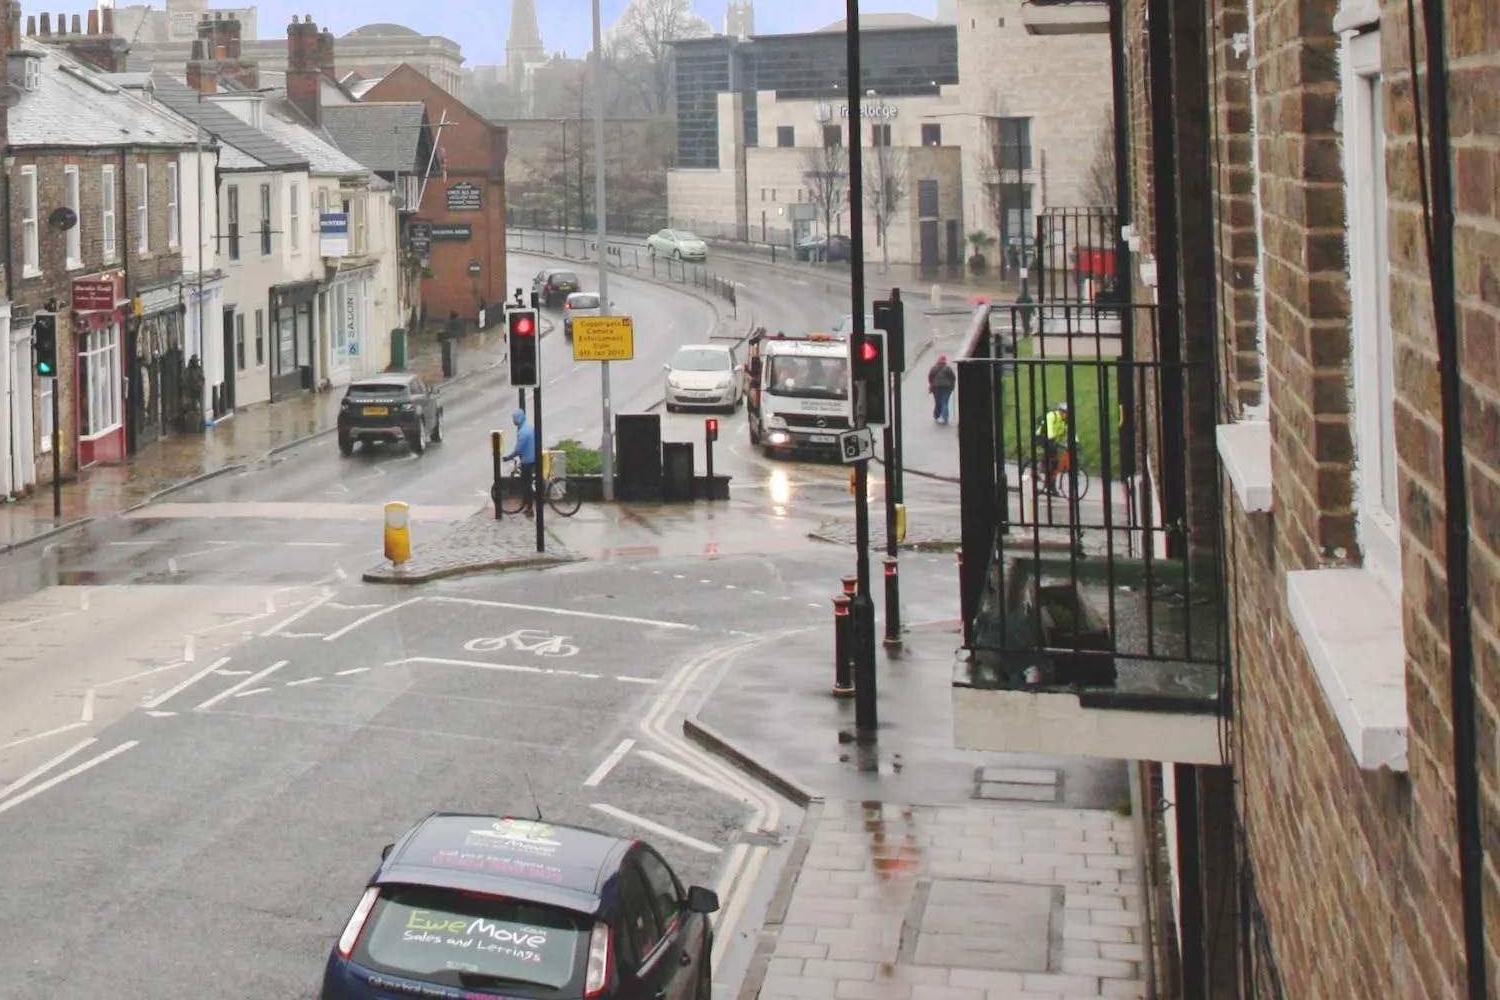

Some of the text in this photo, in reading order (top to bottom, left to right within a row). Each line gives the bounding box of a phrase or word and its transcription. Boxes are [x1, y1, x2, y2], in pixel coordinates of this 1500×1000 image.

[837, 104, 898, 118] Traelodge
[347, 297, 355, 338] SALON
[403, 930, 541, 962] Sales and Lettings
